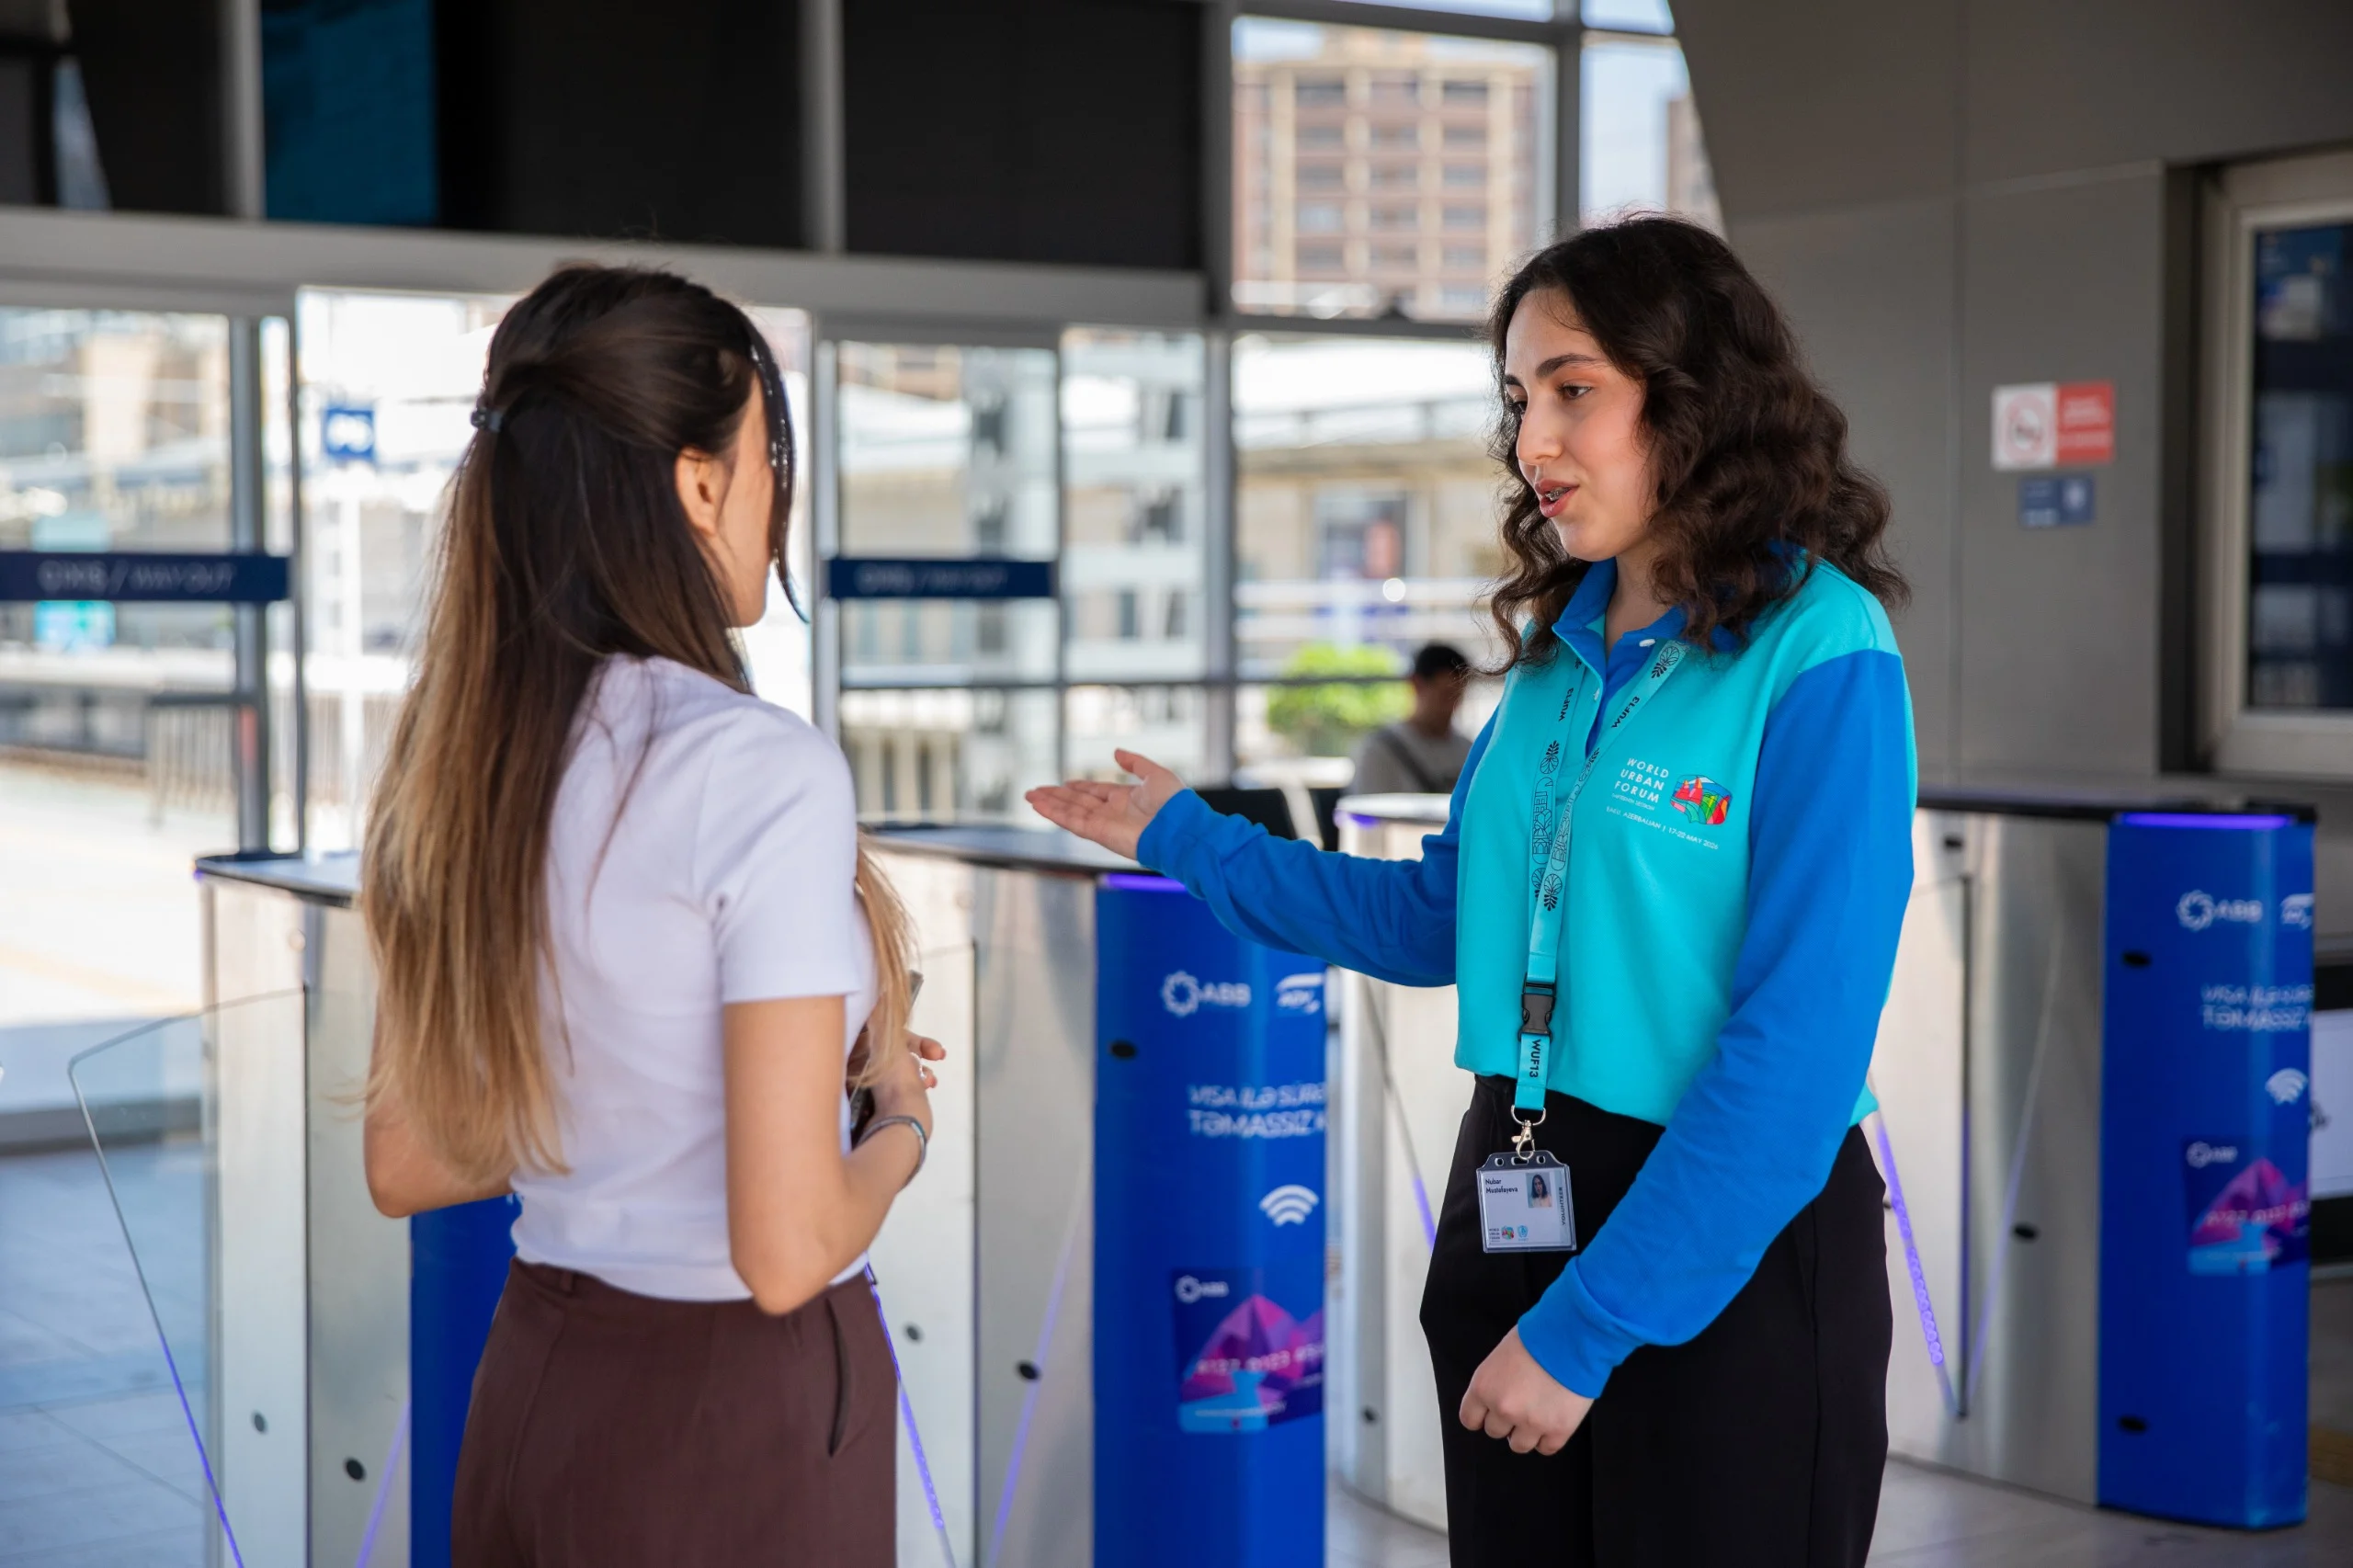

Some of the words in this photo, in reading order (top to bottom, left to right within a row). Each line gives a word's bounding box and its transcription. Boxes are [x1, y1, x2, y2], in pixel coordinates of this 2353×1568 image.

[1558, 687, 1574, 722] WUF13
[1611, 695, 1641, 729] WUF13
[1620, 768, 1665, 791] URBAN
[1627, 757, 1669, 778] WORLD
[1614, 780, 1660, 803] FORUM
[1622, 812, 1661, 829] AZERBAIJAN
[1687, 834, 1703, 844] MAY
[1703, 840, 1719, 850] 2026
[2215, 899, 2263, 923] ABB
[1200, 983, 1251, 1007] ABB
[1529, 1039, 1541, 1078] WUF13
[1188, 1085, 1238, 1108] VISA
[1485, 1186, 1518, 1194] Mustafayeva
[1558, 1187, 1566, 1226] VOLUNTEER
